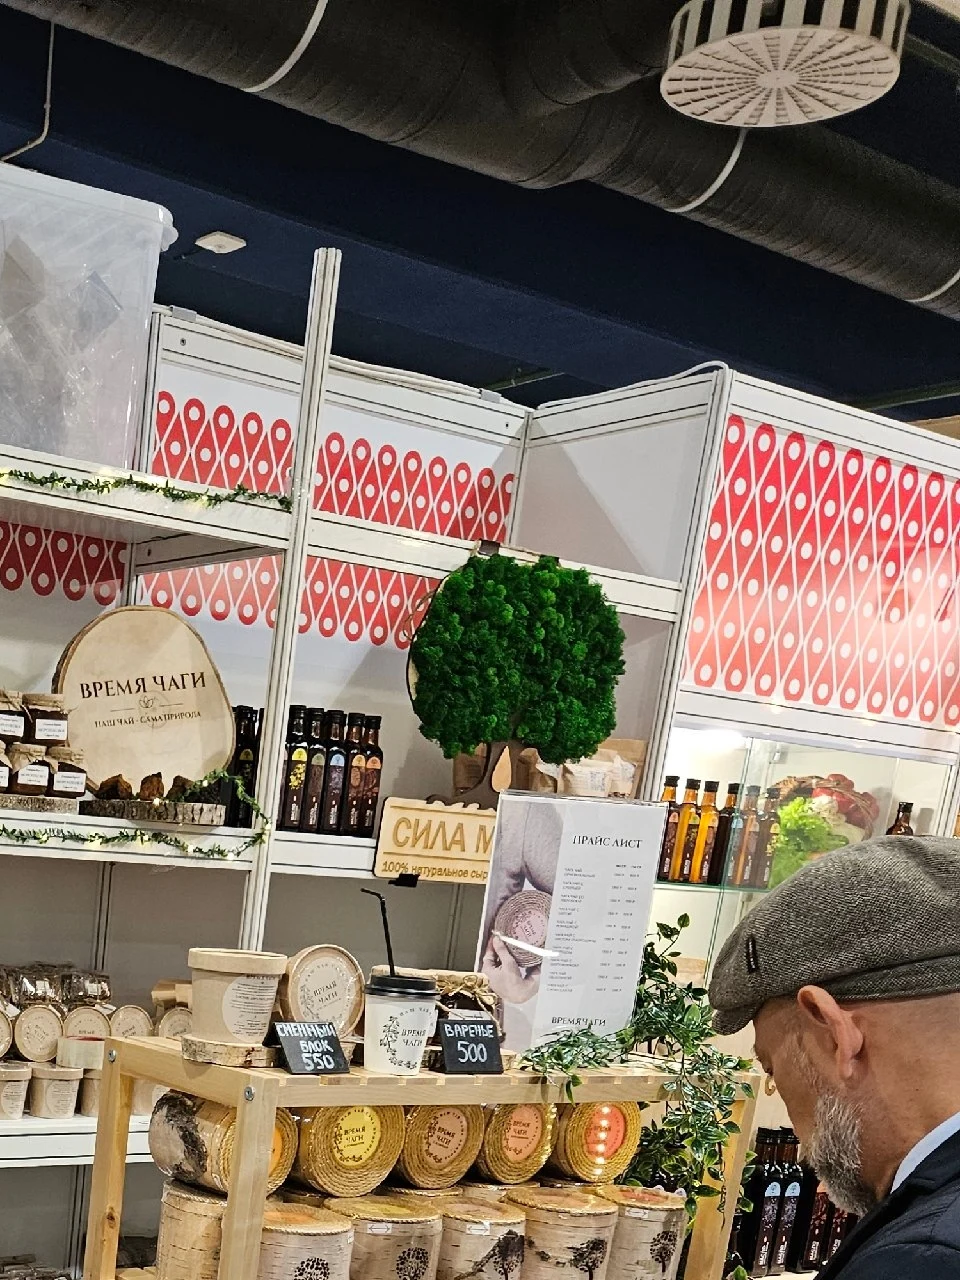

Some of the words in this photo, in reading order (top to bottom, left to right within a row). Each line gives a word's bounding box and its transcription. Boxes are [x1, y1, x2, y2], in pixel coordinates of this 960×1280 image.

[80, 677, 147, 699] ВРЕМЯ
[152, 671, 206, 692] ЧАГИ
[392, 815, 466, 853] СИЛА
[476, 824, 495, 854] М
[572, 835, 610, 847] ПРАЙС
[611, 838, 643, 849] ЛИСТ
[382, 860, 409, 874] 100%
[411, 865, 469, 879] натуральное
[470, 870, 489, 881] сыр
[551, 1016, 582, 1026] ВРЕМЯ
[444, 1023, 494, 1038] ВАРЕНЬЕ
[299, 1039, 334, 1053] БЛОК
[457, 1040, 488, 1063] 500
[301, 1053, 335, 1070] 550
